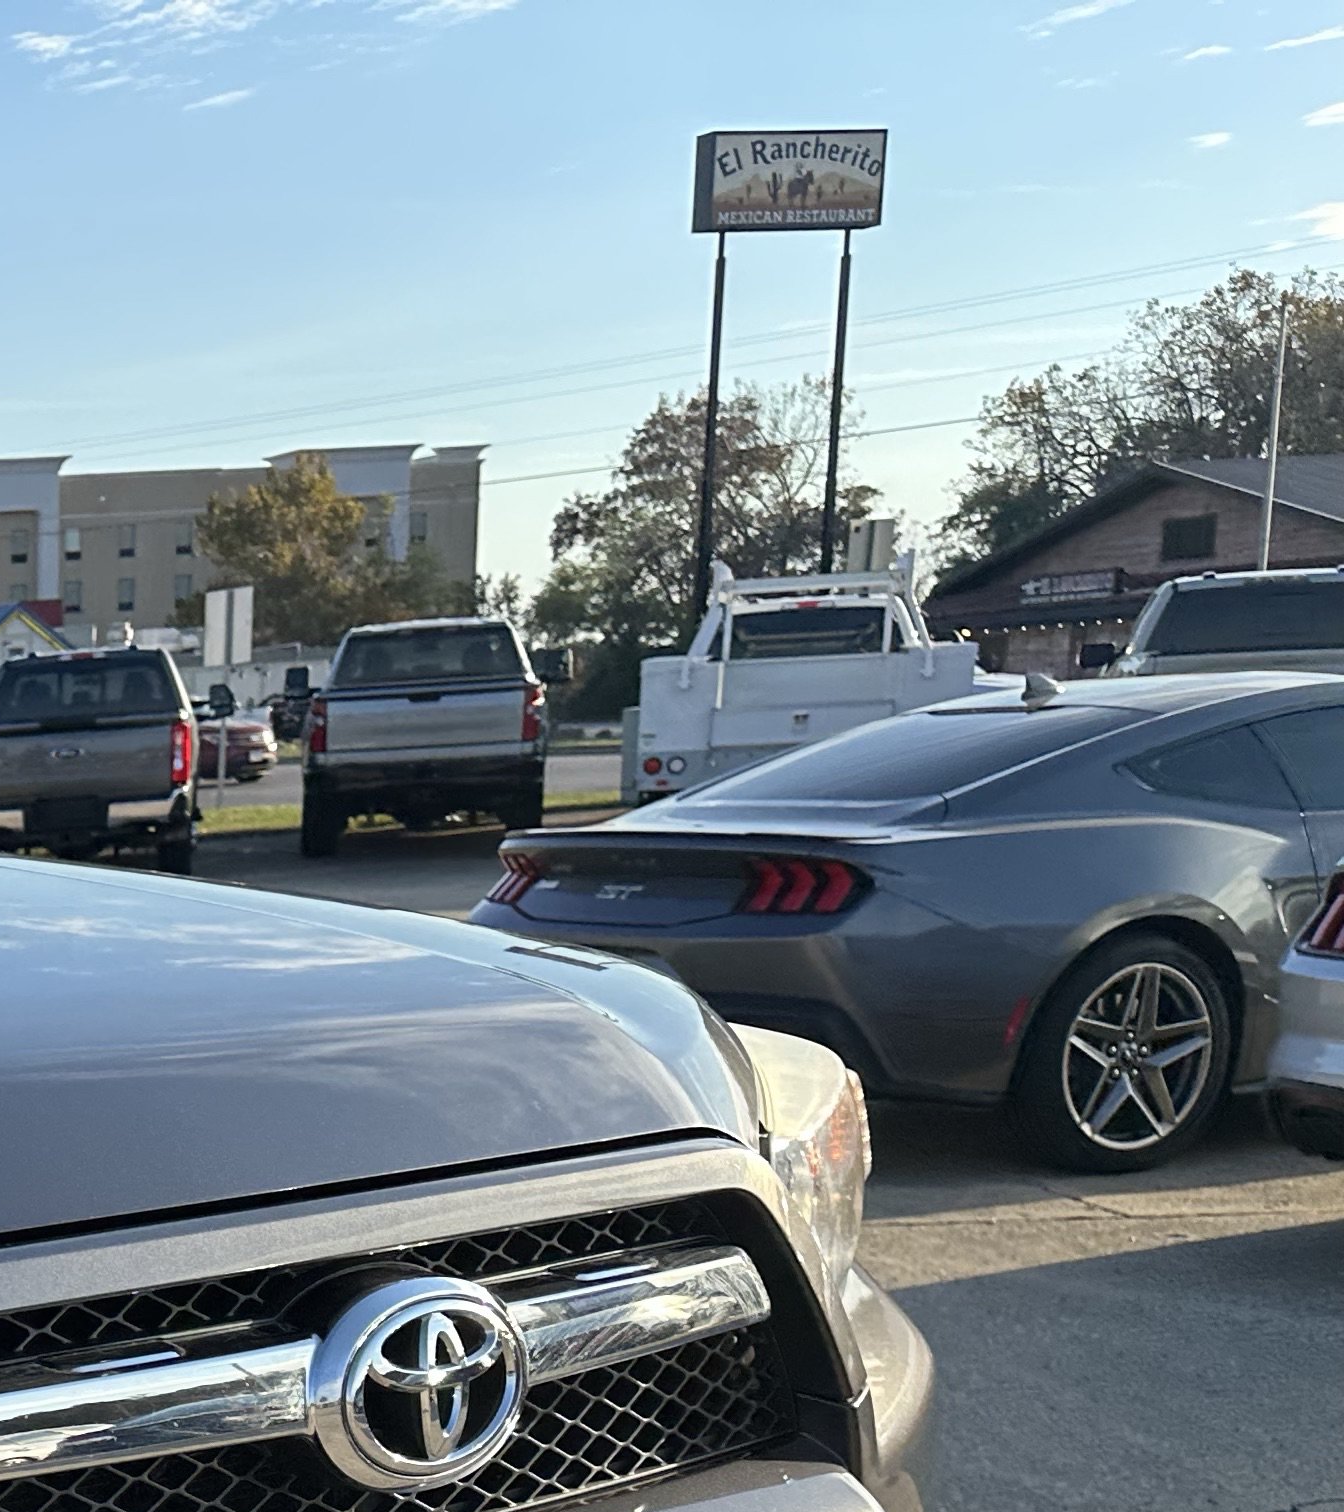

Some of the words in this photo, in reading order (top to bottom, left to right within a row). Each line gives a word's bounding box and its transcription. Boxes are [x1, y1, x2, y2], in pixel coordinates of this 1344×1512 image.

[717, 148, 743, 177] El
[751, 136, 882, 177] Rancherito
[717, 211, 784, 224] MEXICAN
[786, 208, 876, 223] RESTAURANT
